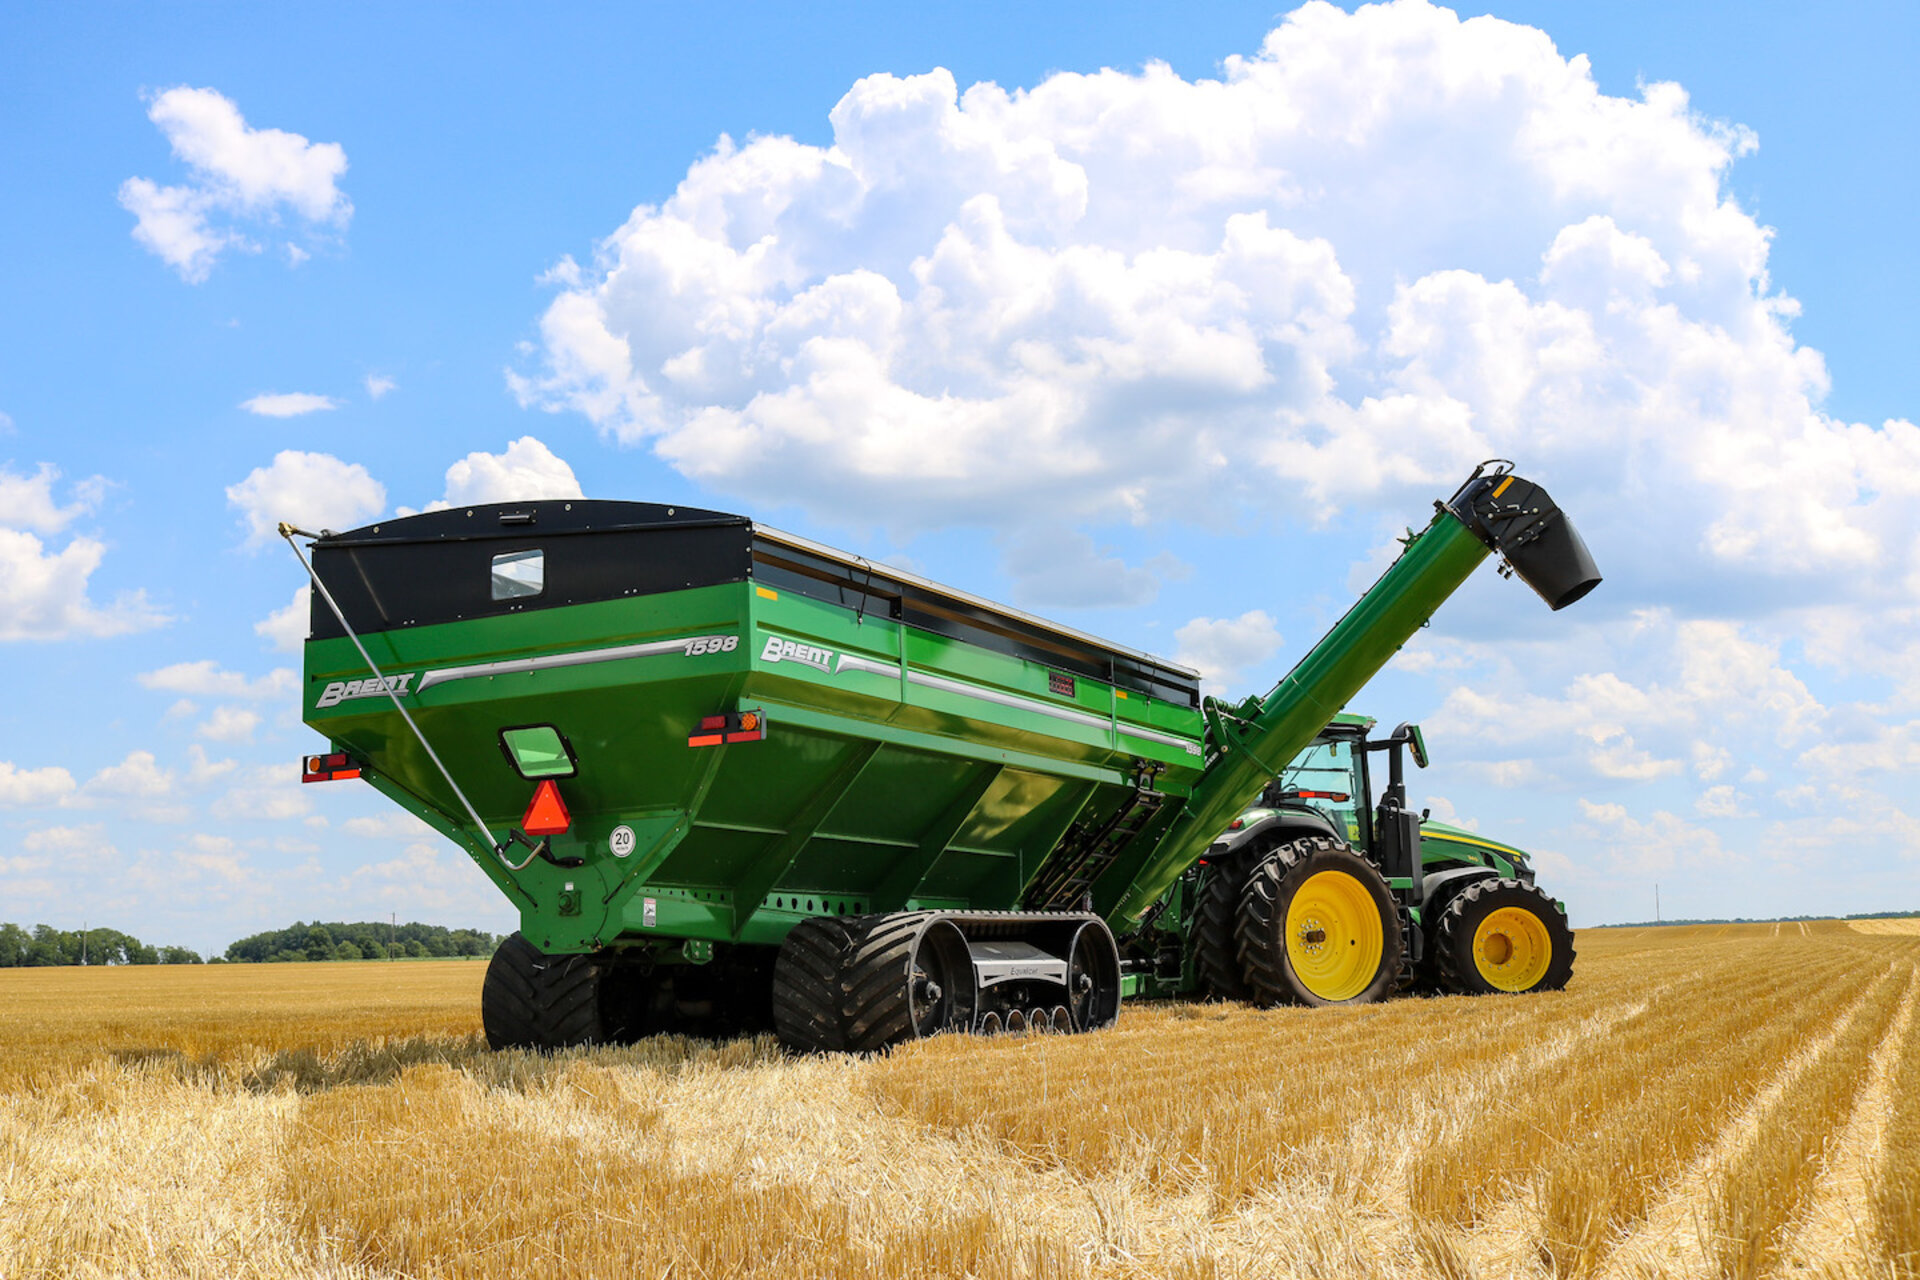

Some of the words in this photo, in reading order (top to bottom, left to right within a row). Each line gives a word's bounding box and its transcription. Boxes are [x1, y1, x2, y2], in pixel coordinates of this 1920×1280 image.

[685, 635, 739, 657] 1598
[760, 636, 833, 671] BRENT
[315, 673, 415, 708] BRENT
[615, 832, 630, 845] 20
